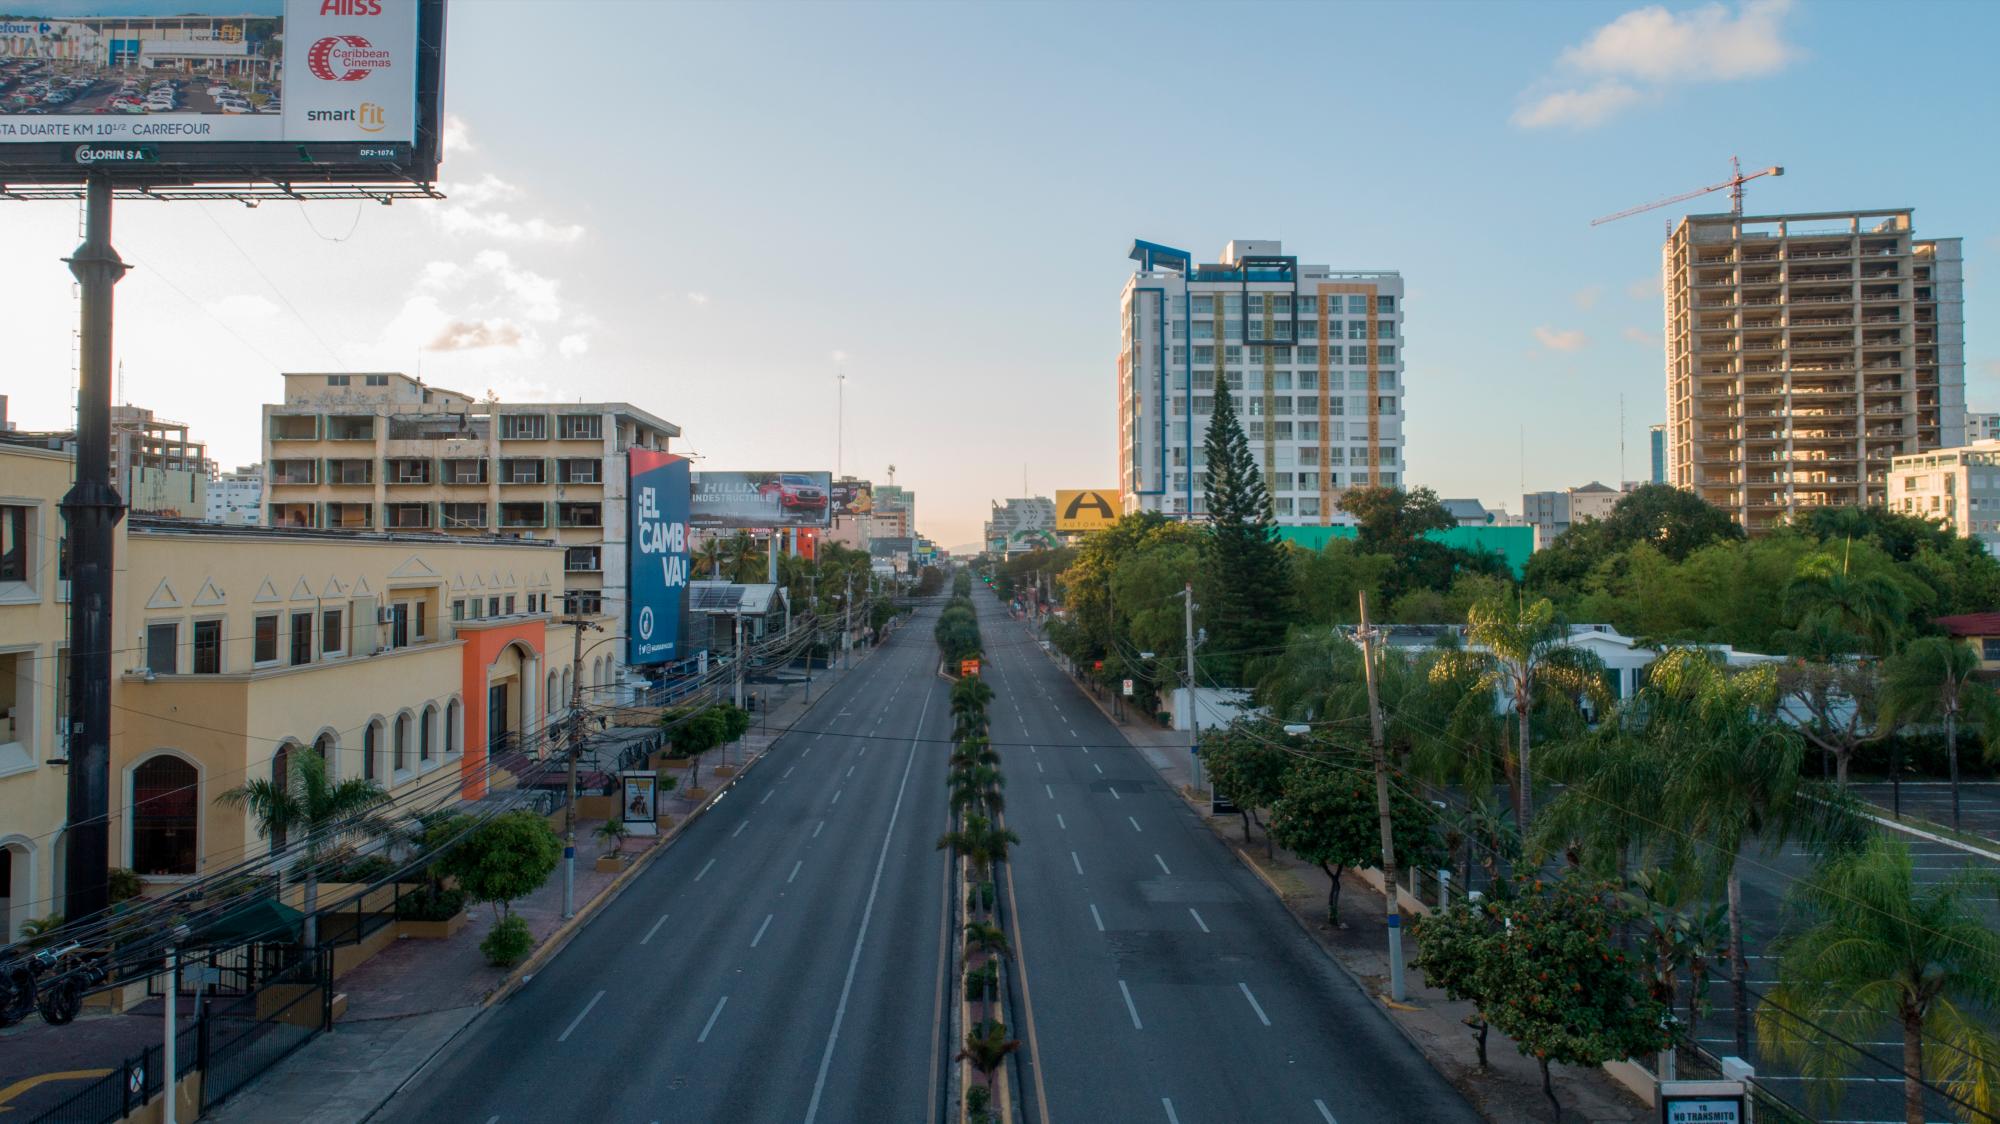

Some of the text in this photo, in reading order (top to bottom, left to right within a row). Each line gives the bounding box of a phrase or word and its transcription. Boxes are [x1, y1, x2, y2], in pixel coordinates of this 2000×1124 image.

[333, 49, 390, 58] Caribbean
[343, 58, 391, 67] Cinemas
[307, 102, 385, 124] smart fit
[0, 124, 17, 135] TA
[20, 124, 70, 135] DUARTE
[73, 124, 93, 135] KM
[132, 123, 210, 135] CARREFOUR
[704, 482, 759, 493] HILUX
[692, 494, 773, 503] INDESTRUCTIBLE
[662, 556, 687, 588] VA!
[1673, 1111, 1735, 1121] NO TRANSMITO
